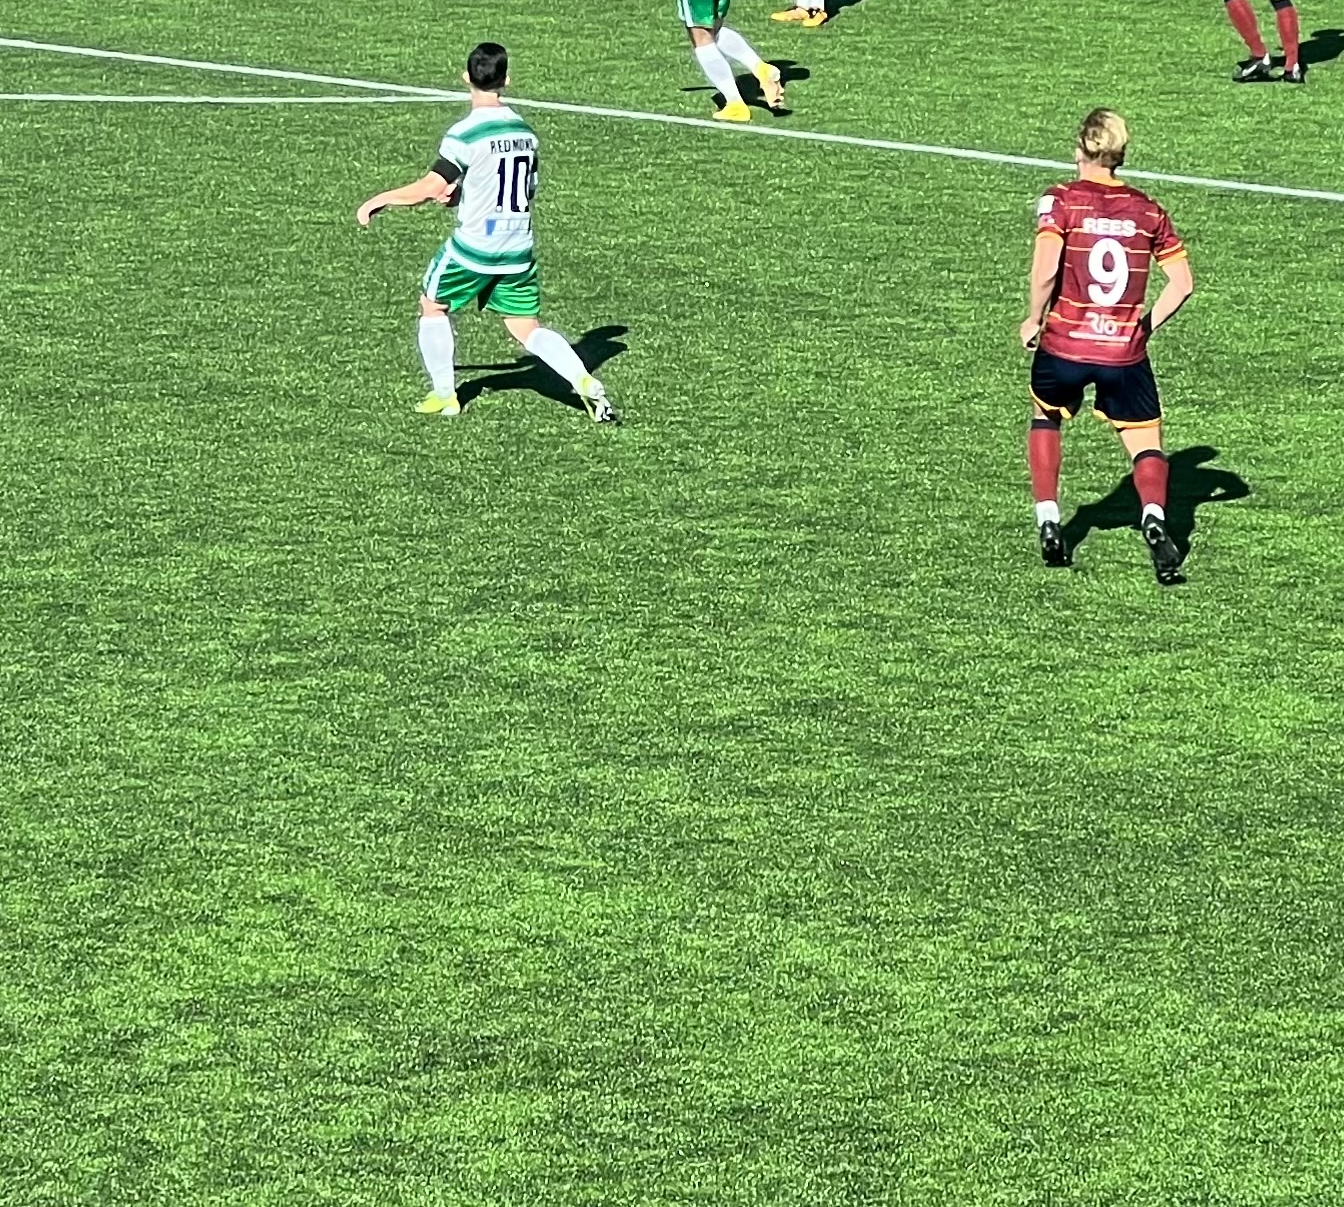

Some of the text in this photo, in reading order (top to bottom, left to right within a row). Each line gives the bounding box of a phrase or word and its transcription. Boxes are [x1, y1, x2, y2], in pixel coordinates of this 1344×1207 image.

[495, 155, 530, 213] 10
[1082, 217, 1137, 237] REES
[1087, 237, 1130, 307] 9
